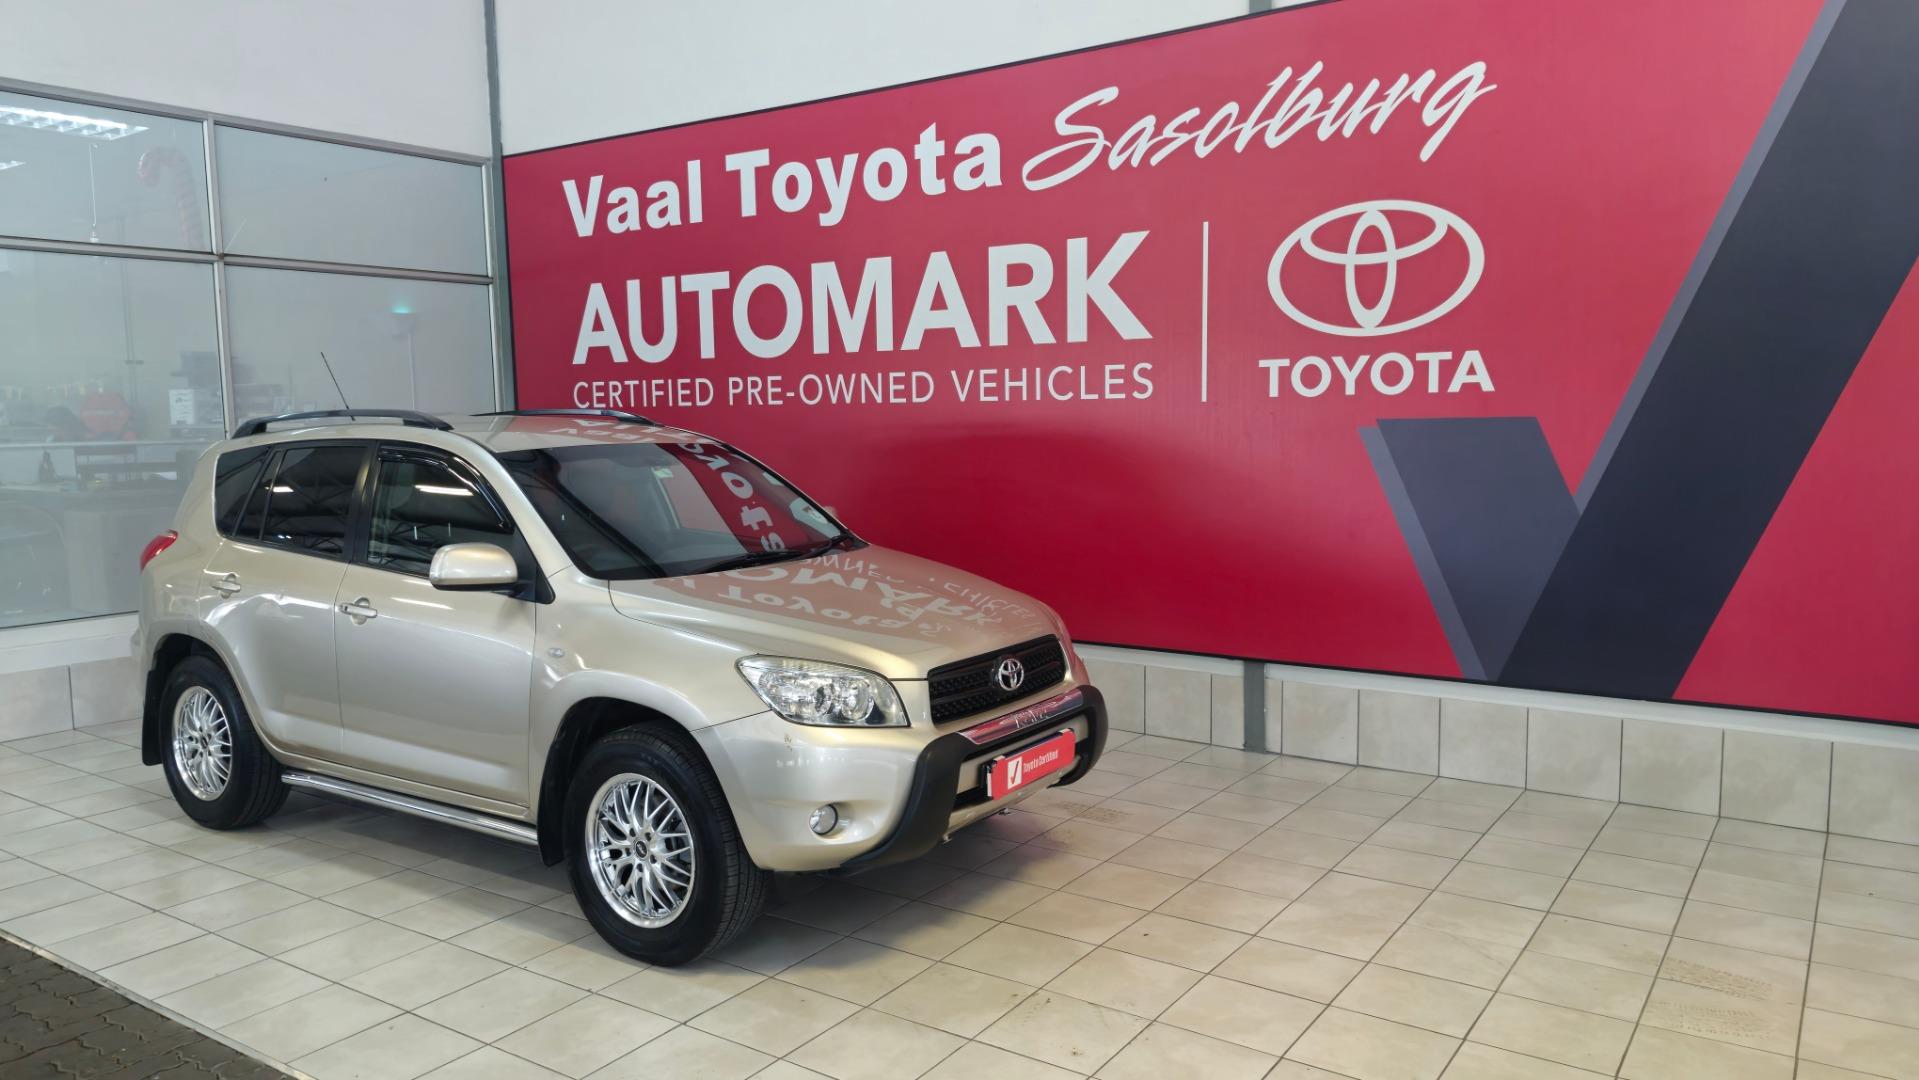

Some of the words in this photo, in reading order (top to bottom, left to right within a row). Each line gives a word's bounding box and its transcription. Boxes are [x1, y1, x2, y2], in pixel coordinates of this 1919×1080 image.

[562, 160, 703, 238] Vaal
[725, 122, 1002, 227] Toyota
[1021, 60, 1497, 192] Sasolburg
[572, 230, 1153, 365] AUTOMARK
[573, 377, 715, 409] CERTIFIED
[727, 370, 936, 406] PRE-OWNED
[950, 362, 1155, 402] VEHICLES
[1258, 349, 1496, 398] TOYOTA
